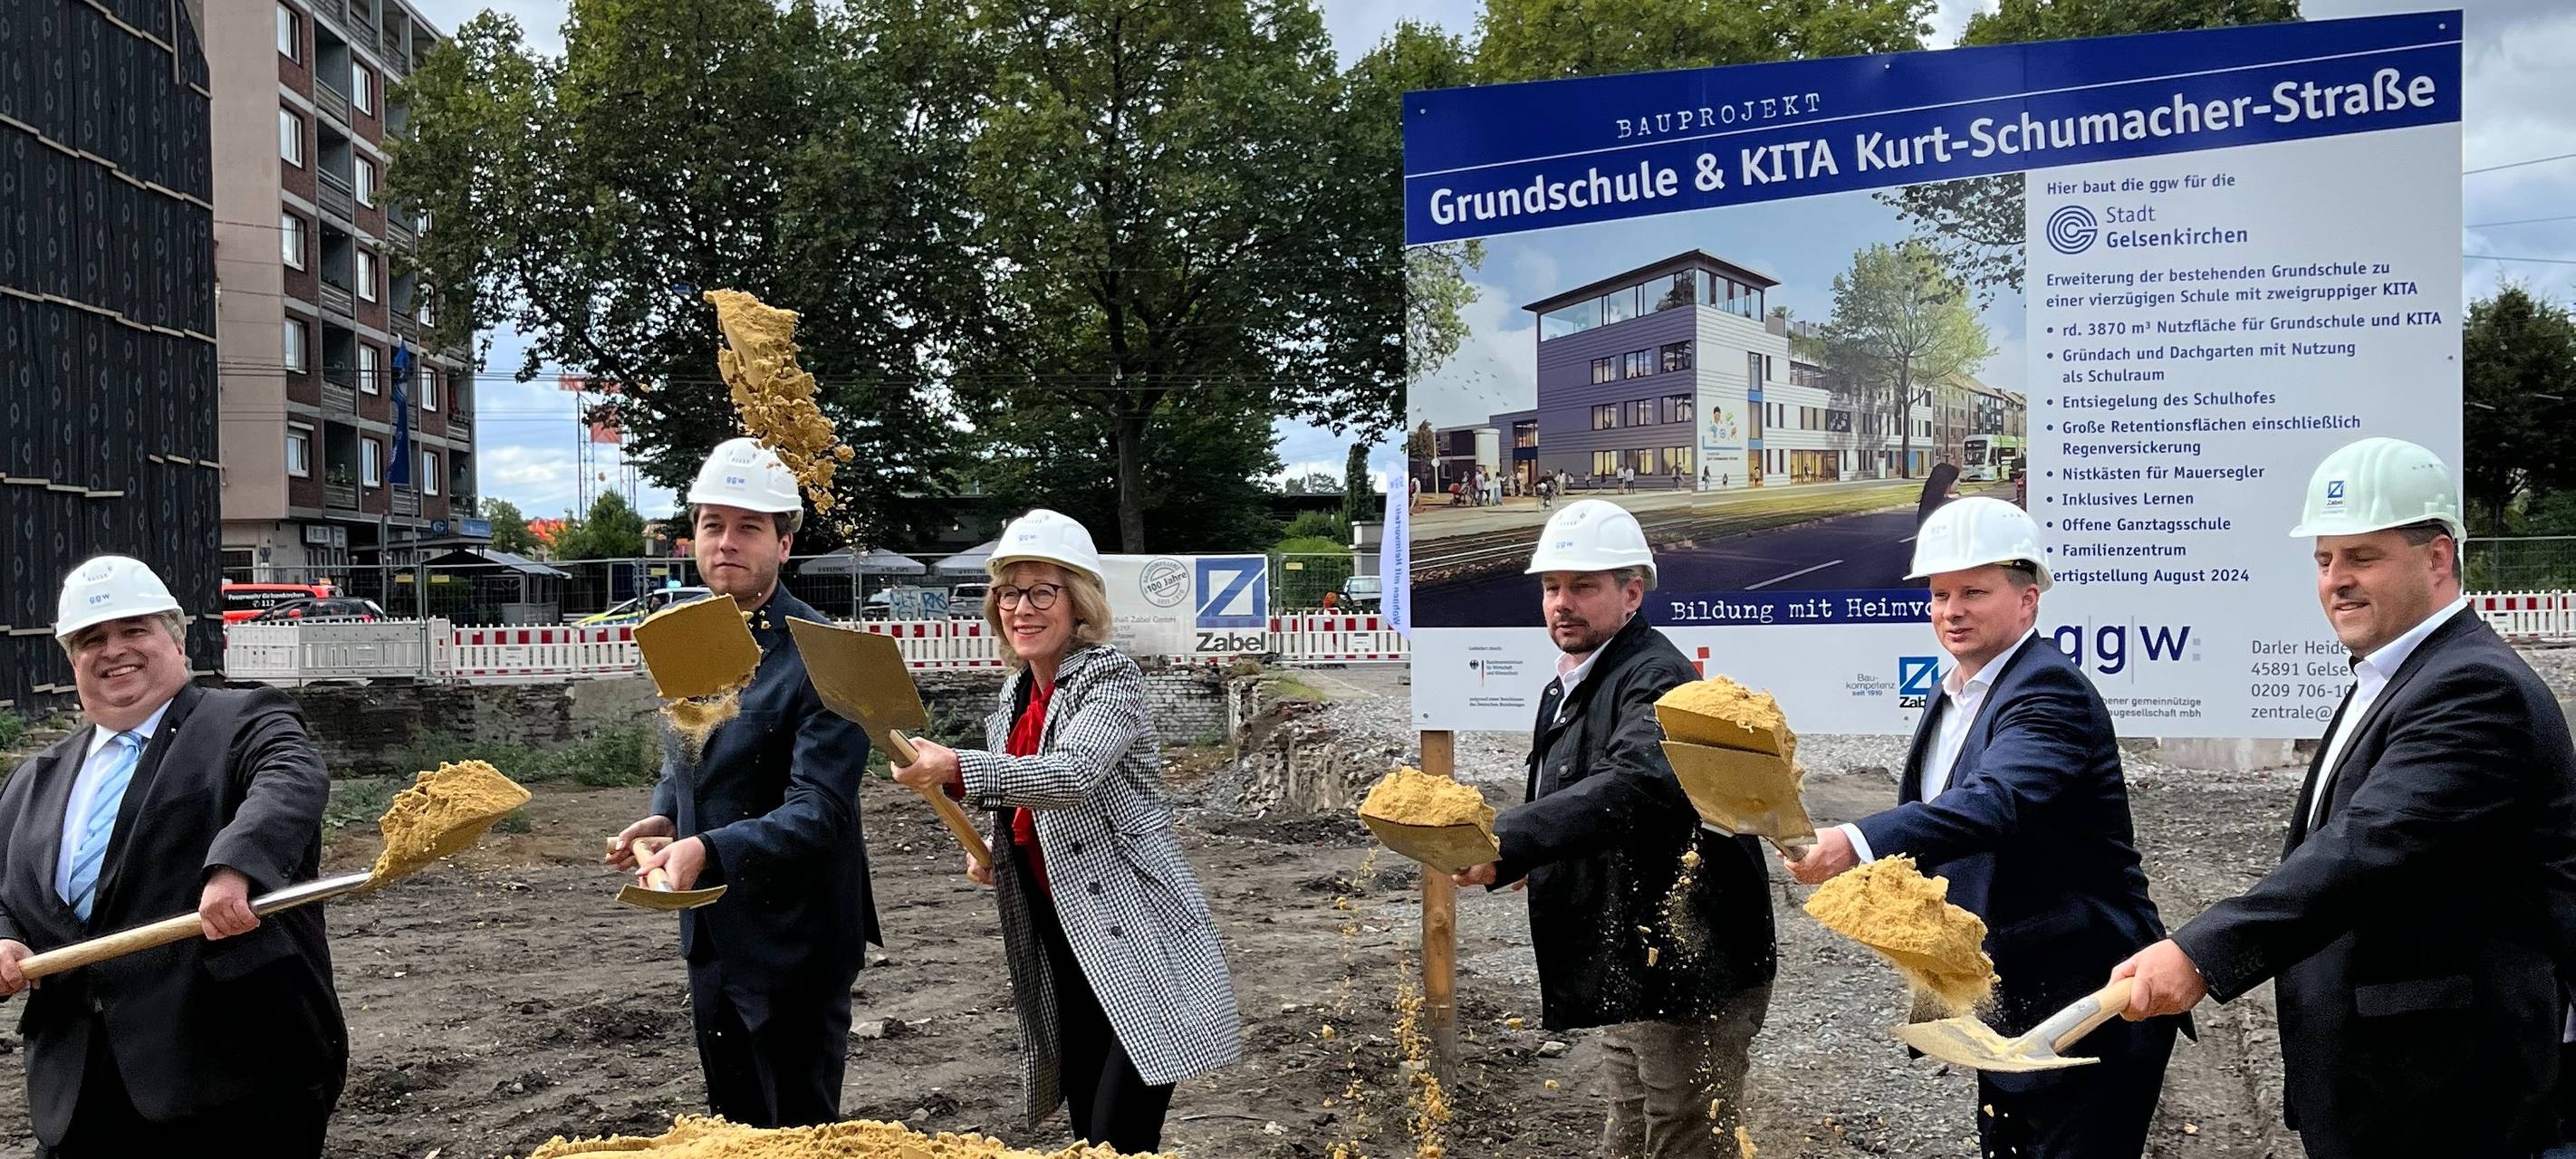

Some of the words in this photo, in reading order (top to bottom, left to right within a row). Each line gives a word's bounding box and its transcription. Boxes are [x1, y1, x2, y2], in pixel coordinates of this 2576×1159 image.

[1617, 93, 1820, 138] BAUPROJEKT
[1431, 161, 1677, 225] Grundschule
[1695, 153, 1725, 191] &
[1742, 139, 1839, 185] KITA
[1857, 69, 2435, 171] Kurt-Schumacher-Straße
[2048, 182, 2077, 195] Hier
[2083, 181, 2116, 193] baut
[2122, 178, 2143, 191] die
[2150, 180, 2178, 193] ggw
[2184, 175, 2206, 187] für
[2213, 174, 2235, 187] die
[2107, 205, 2156, 223] Stadt
[2107, 227, 2247, 247] Gelsenkirchen
[2047, 273, 2133, 286] Erweiterung
[2140, 270, 2164, 283] der
[2169, 266, 2264, 282] bestehenden
[2273, 262, 2366, 277] Grundschule
[2373, 264, 2389, 273] zu
[2047, 295, 2084, 307] einer
[2090, 292, 2174, 307] vierzügigen
[2181, 289, 2229, 302] Schule
[2236, 288, 2261, 301] mit
[2267, 284, 2377, 302] zweigruppiger
[2384, 283, 2417, 295] KITA
[2063, 323, 2081, 336] rd.
[2089, 322, 2125, 335] 3870
[2158, 319, 2235, 332] Nutzfläche
[2243, 318, 2264, 330] für
[2271, 314, 2364, 330] Grundschule
[2372, 312, 2399, 326] und
[2408, 312, 2441, 325] KITA
[2063, 348, 2129, 361] Gründach
[2138, 347, 2163, 359] und
[2171, 345, 2253, 360] Dachgarten
[2261, 343, 2285, 356] mit
[2292, 343, 2355, 357] Nutzung
[2063, 370, 2082, 383] als
[2089, 369, 2164, 382] Schulraum
[2063, 395, 2157, 410] Entsiegelung
[2164, 393, 2187, 406] des
[2194, 391, 2275, 405] Schulhofes
[2063, 421, 2105, 434] Große
[2112, 418, 2245, 432] Retentionsflächen
[2253, 416, 2360, 430] einschließlich
[2063, 441, 2200, 457] Regenversickerung
[2063, 467, 2139, 480] Nistkästen
[2147, 466, 2168, 479] für
[2175, 465, 2264, 481] Mauersegler
[2062, 493, 2137, 505] Inklusives
[2145, 493, 2193, 504] Lernen
[2063, 519, 2110, 531] Offene
[2118, 517, 2230, 533] Ganztagsschule
[2063, 543, 2186, 556] Familienzentrum
[1147, 580, 1162, 593] 100
[1164, 572, 1187, 587] Jahre
[2054, 570, 2148, 584] ertigstellung
[2154, 570, 2205, 584] August
[2212, 570, 2249, 581] 2024
[1671, 600, 1773, 623] Bildung
[1789, 599, 1831, 618] mit
[1847, 599, 1932, 618] Heimvo
[1196, 632, 1265, 651] Zabel
[2253, 640, 2298, 654] Darler
[2251, 663, 2299, 675] 45891
[1846, 682, 1895, 690] kompetenz
[2252, 684, 2290, 697] 0209
[1899, 696, 1926, 707] Zab
[2132, 697, 2201, 707] gemeinnützige
[2179, 709, 2201, 717] mbh
